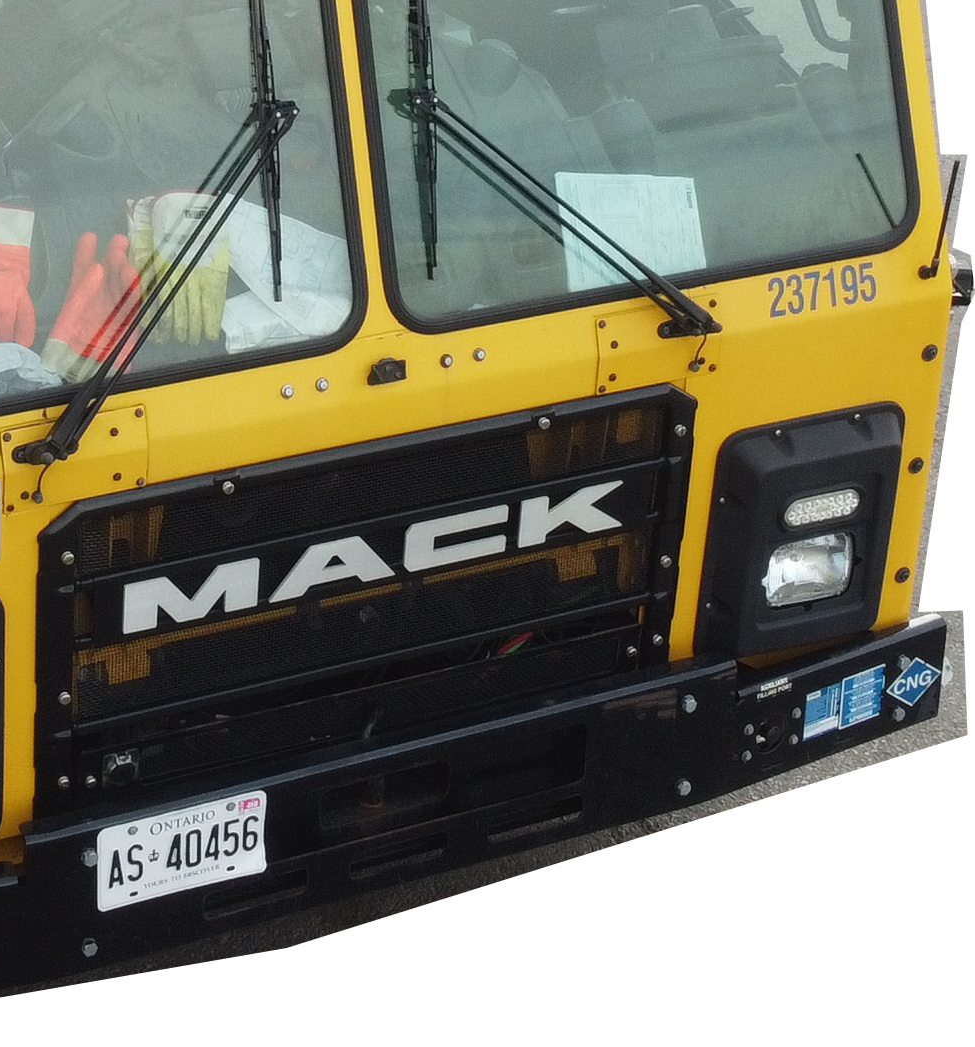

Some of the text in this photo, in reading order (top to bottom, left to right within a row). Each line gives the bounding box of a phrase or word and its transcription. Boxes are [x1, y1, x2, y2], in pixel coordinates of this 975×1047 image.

[767, 261, 877, 318] 237195
[123, 479, 625, 635] MACK
[893, 669, 933, 696] CNG
[149, 809, 216, 836] ONTARIO
[108, 814, 260, 889] AS 40456
